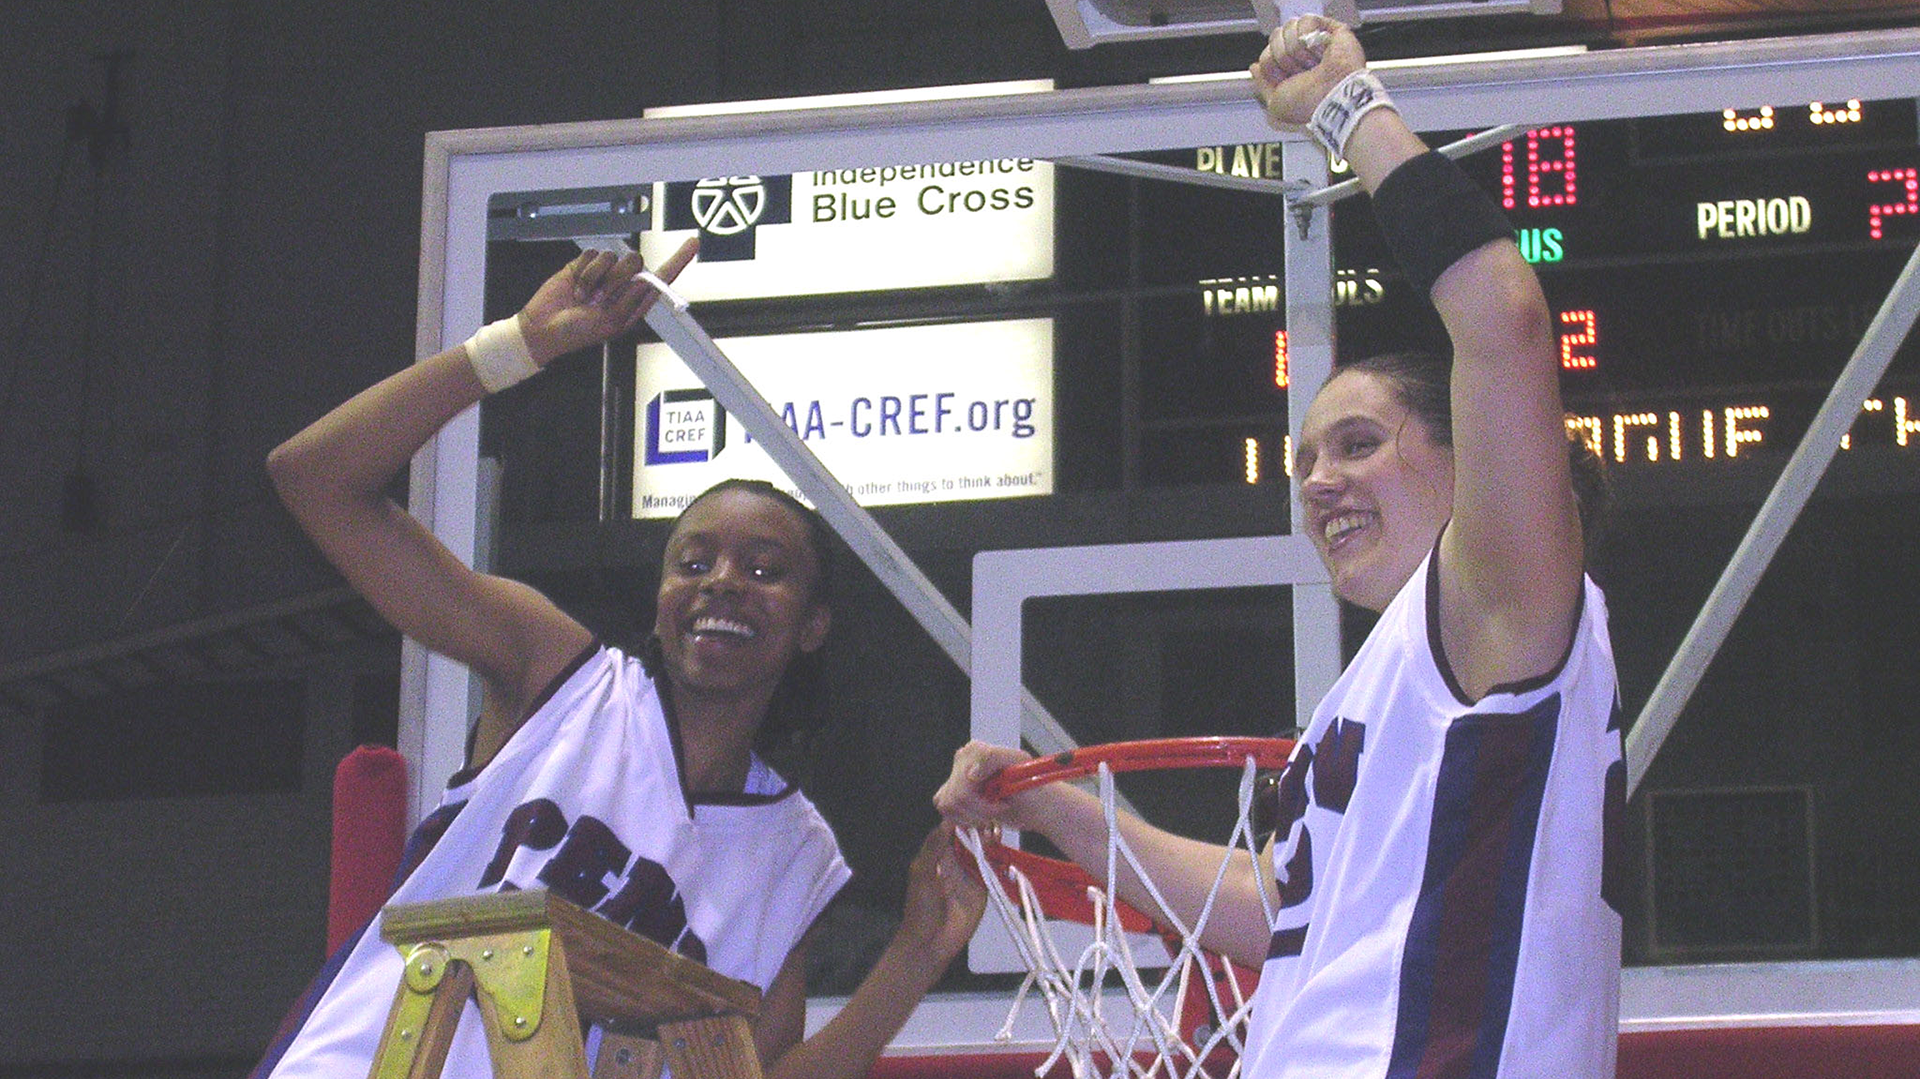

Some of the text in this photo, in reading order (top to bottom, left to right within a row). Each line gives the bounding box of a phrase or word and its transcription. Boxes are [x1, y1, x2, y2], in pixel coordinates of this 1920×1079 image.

[1197, 142, 1282, 180] PLAYE
[812, 184, 1035, 223] Blue Cross
[1697, 195, 1812, 240] PERIOD
[1560, 309, 1597, 369] 2
[664, 427, 707, 443] CREF
[666, 410, 706, 424] TIAA
[744, 391, 1037, 444] AA-CREF.org
[641, 492, 698, 510] Managin
[857, 481, 892, 496] other
[897, 478, 938, 494] things
[941, 477, 955, 491] to
[958, 473, 992, 490] think
[476, 797, 709, 969] PEN
